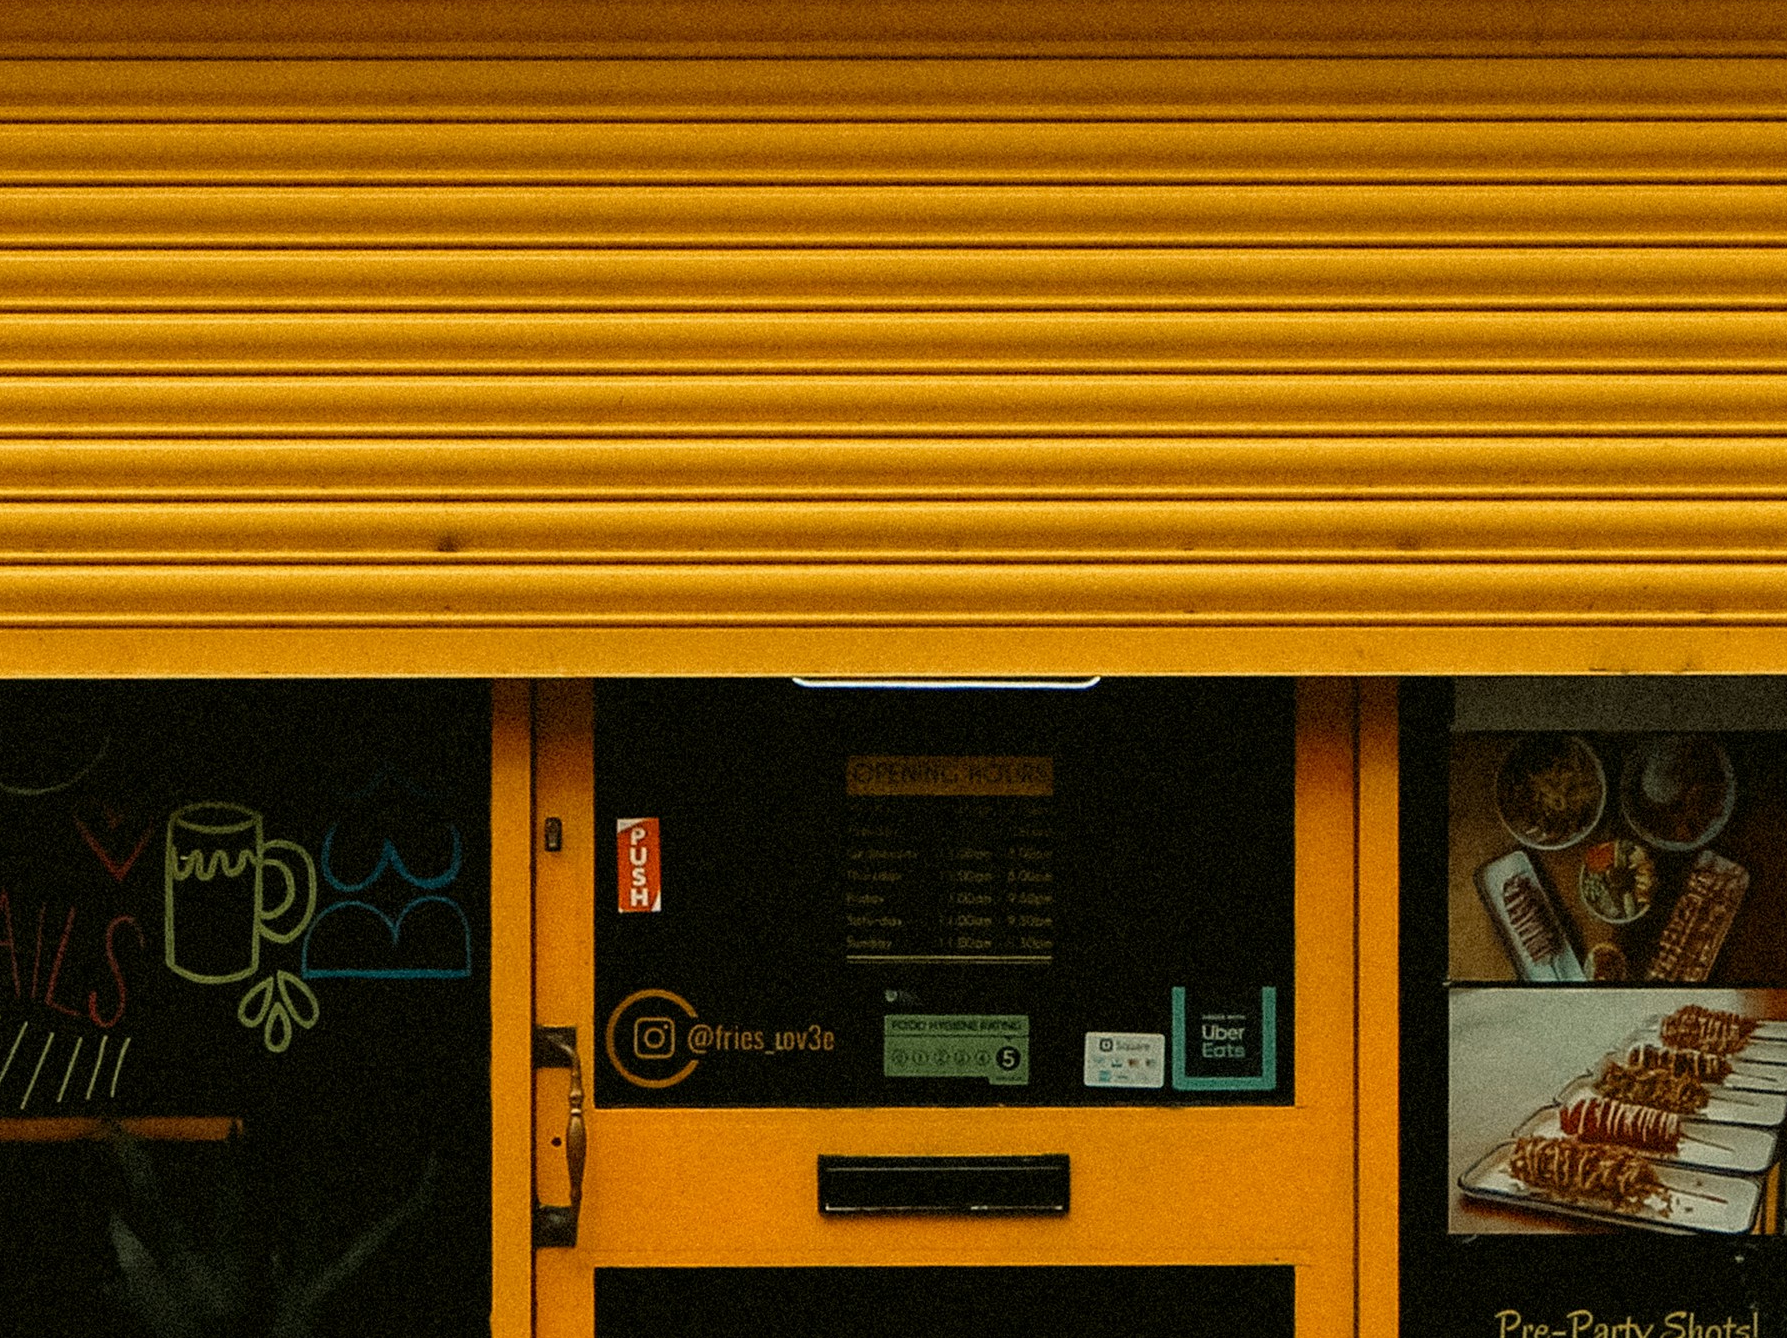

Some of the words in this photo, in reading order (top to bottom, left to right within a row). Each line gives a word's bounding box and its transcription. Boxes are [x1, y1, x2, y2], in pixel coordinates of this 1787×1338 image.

[629, 827, 650, 907] PUSH
[1201, 1024, 1246, 1041] Uber
[1001, 1049, 1016, 1069] 5
[1201, 1043, 1245, 1059] Eats
